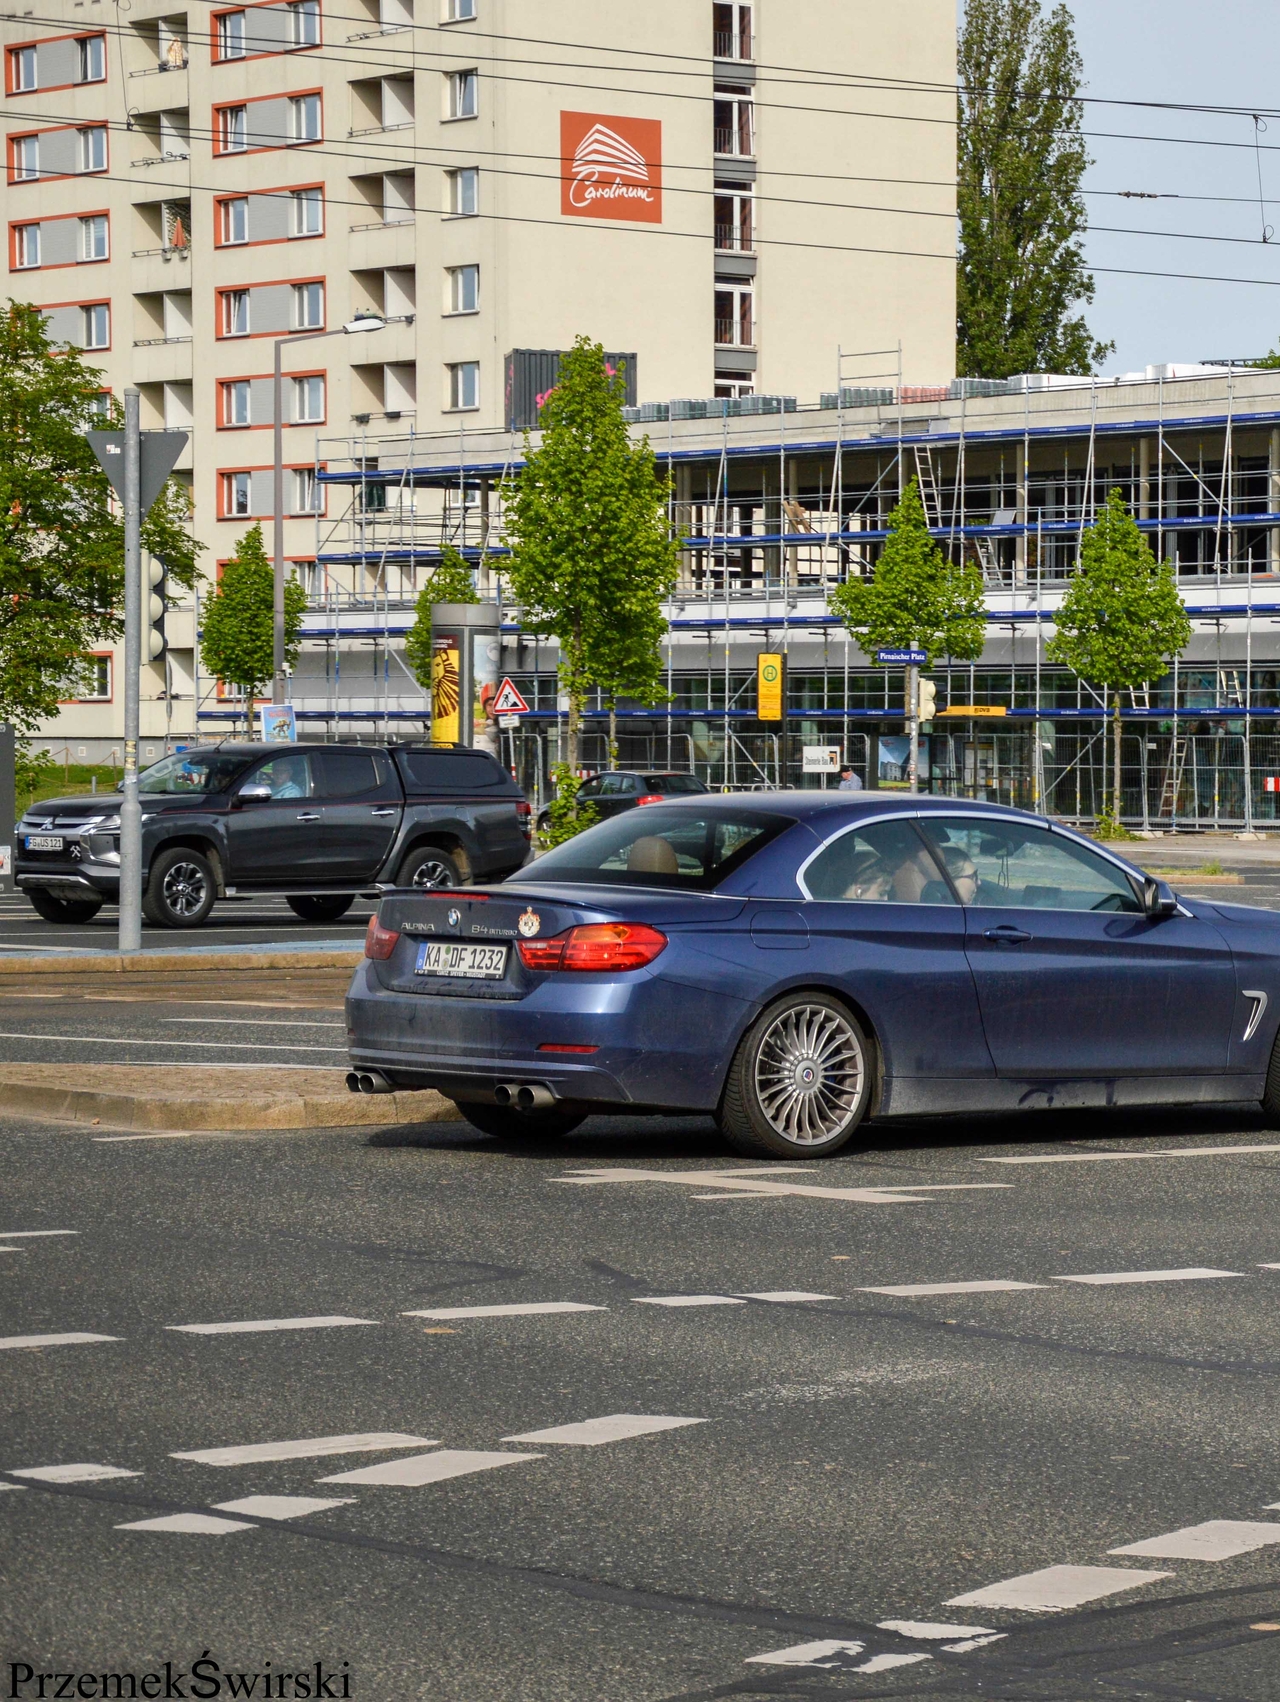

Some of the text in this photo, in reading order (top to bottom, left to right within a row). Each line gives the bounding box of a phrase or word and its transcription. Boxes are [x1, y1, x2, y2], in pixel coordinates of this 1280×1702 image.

[569, 167, 654, 207] Carolinum
[880, 652, 910, 660] Pirnaischer
[50, 839, 62, 848] 121
[401, 922, 435, 932] ALPINA
[471, 925, 518, 936] B4 BITURBO
[424, 946, 504, 971] KA DF 1232
